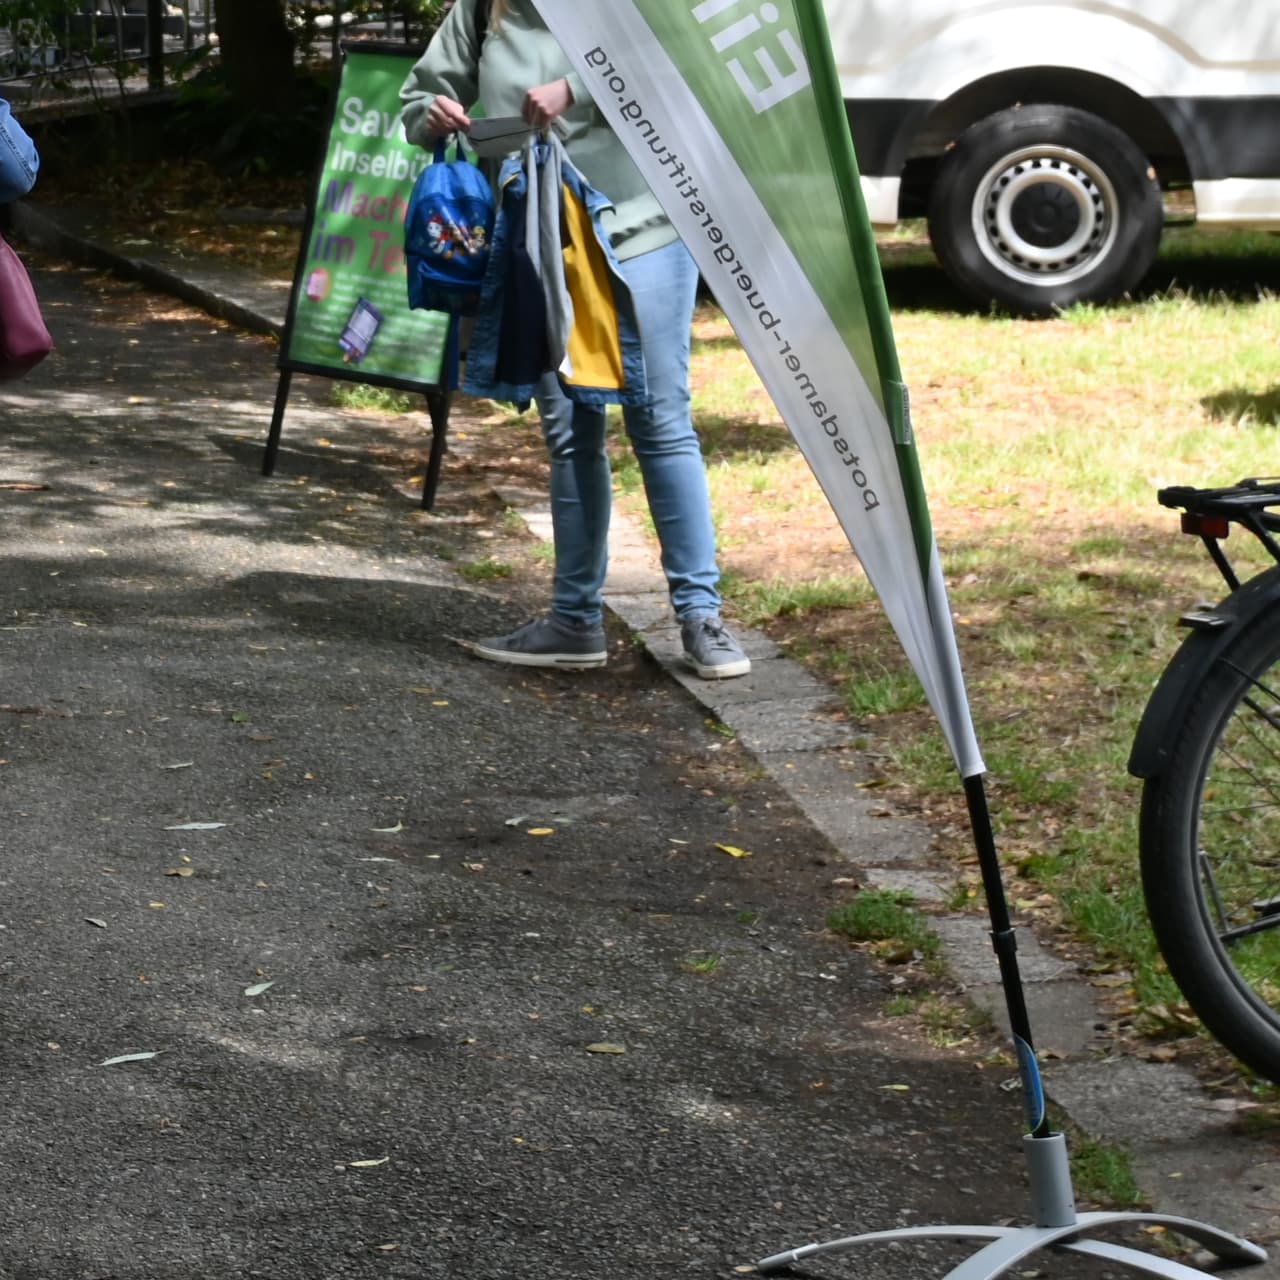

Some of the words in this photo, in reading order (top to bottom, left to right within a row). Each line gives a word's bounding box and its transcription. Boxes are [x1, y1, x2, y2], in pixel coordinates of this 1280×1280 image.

[340, 97, 407, 144] Sav
[331, 141, 434, 184] Inselbü
[313, 222, 357, 265] im
[368, 230, 407, 276] Te
